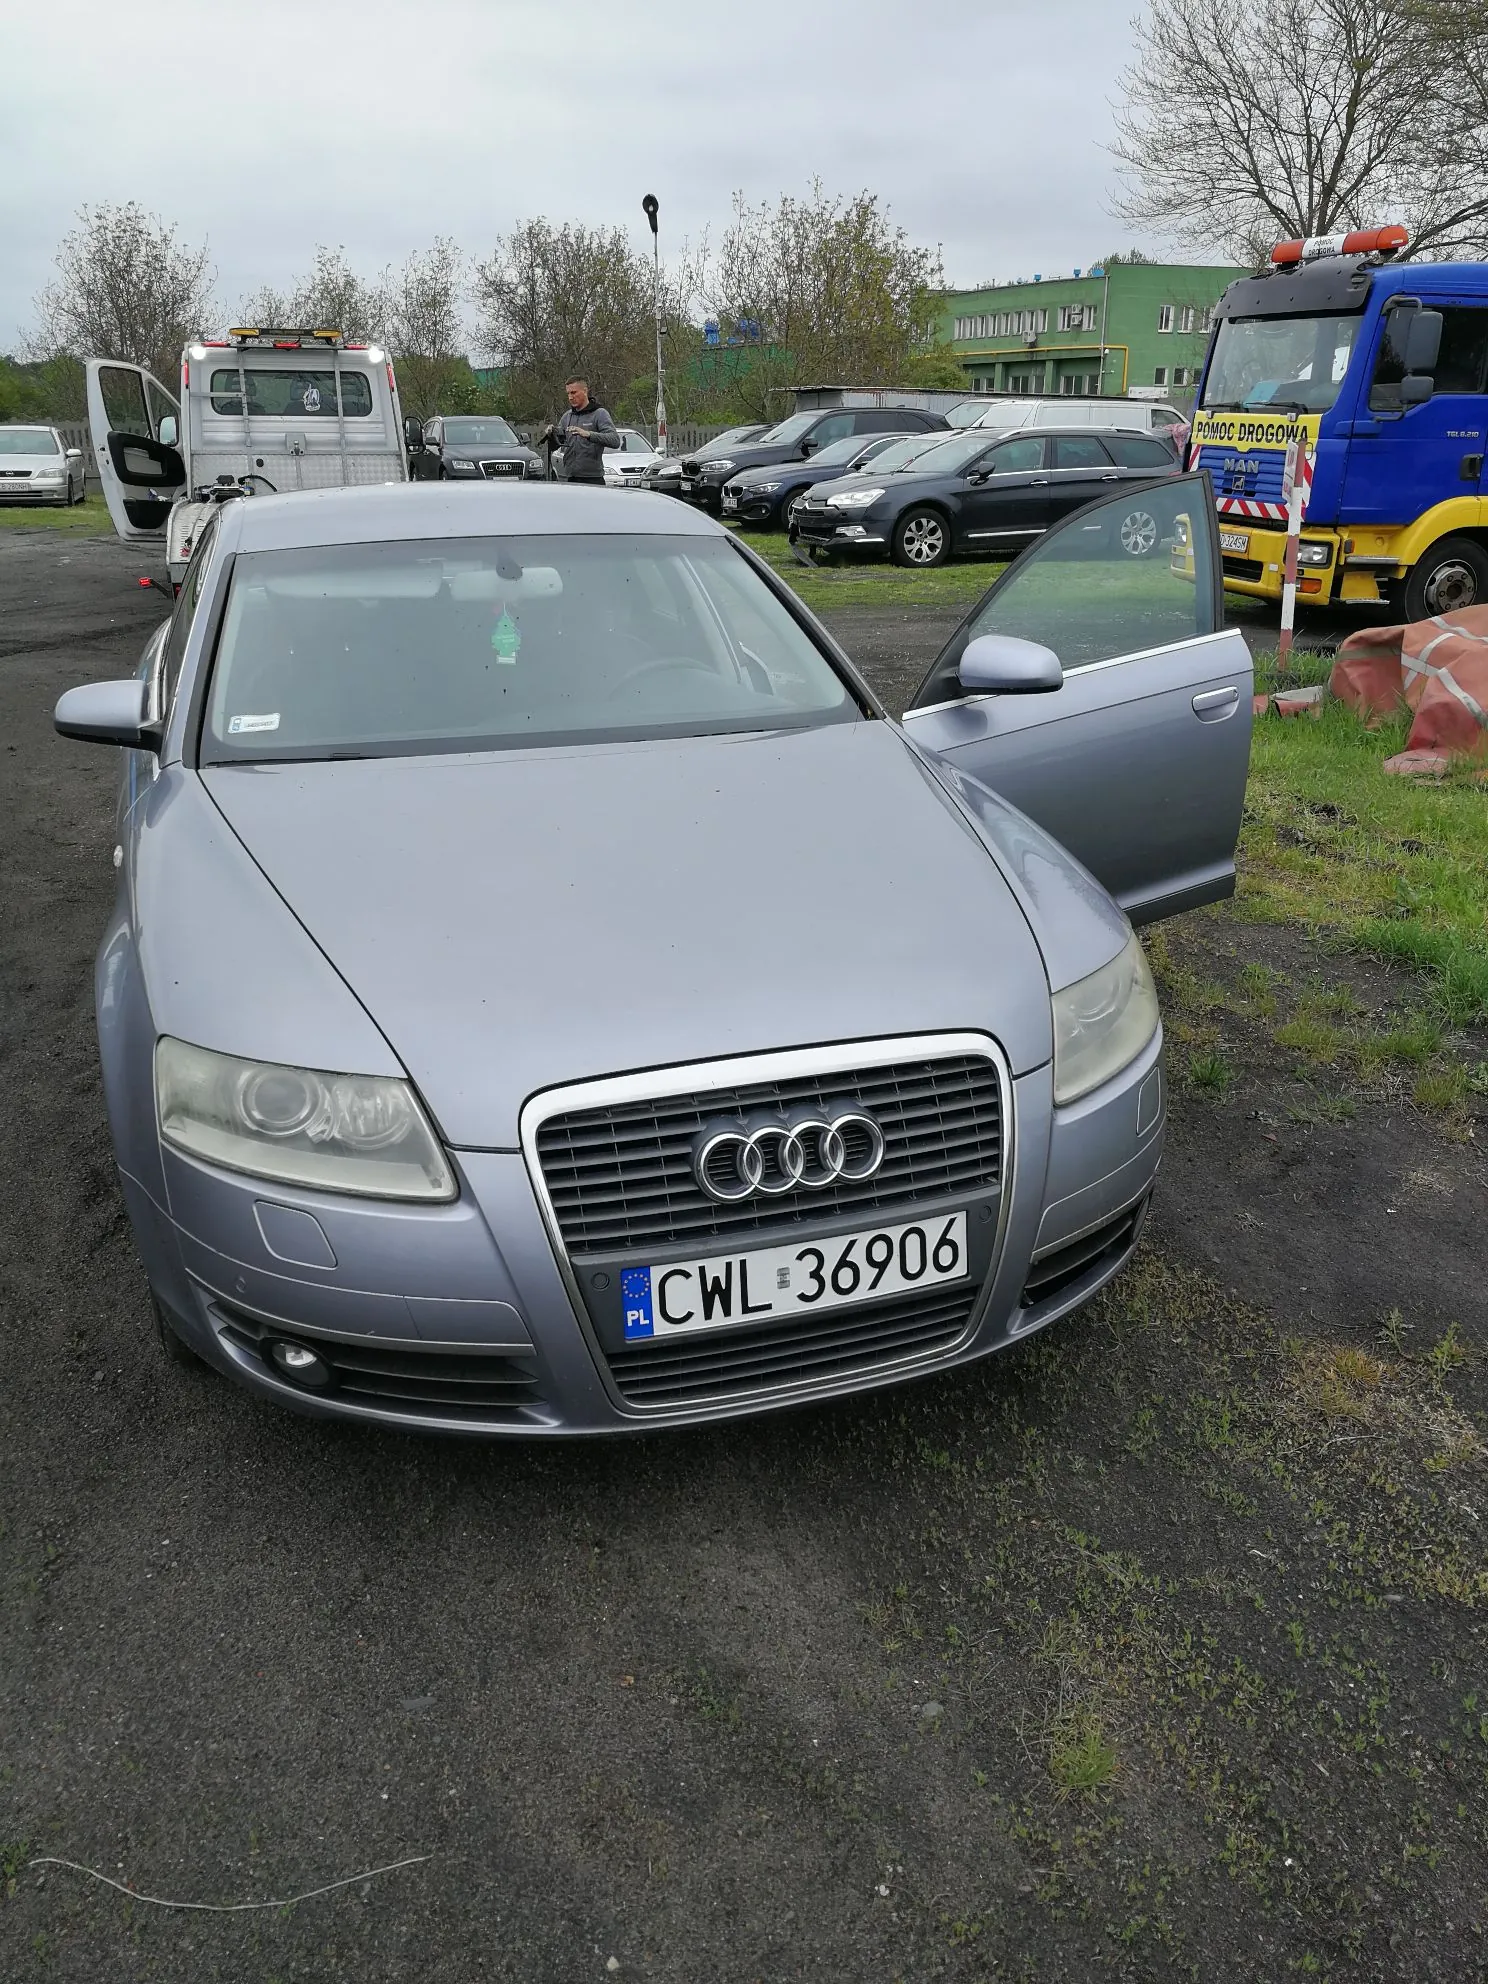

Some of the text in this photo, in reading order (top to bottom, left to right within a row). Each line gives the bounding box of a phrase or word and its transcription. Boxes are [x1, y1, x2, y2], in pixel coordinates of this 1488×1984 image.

[1313, 238, 1335, 247] POMOC
[1308, 246, 1336, 257] DROGOWA
[1196, 421, 1308, 444] POMOC DROGOWA
[1223, 458, 1260, 474] MAN
[658, 1216, 960, 1324] CWL 36906
[626, 1308, 650, 1327] PL
